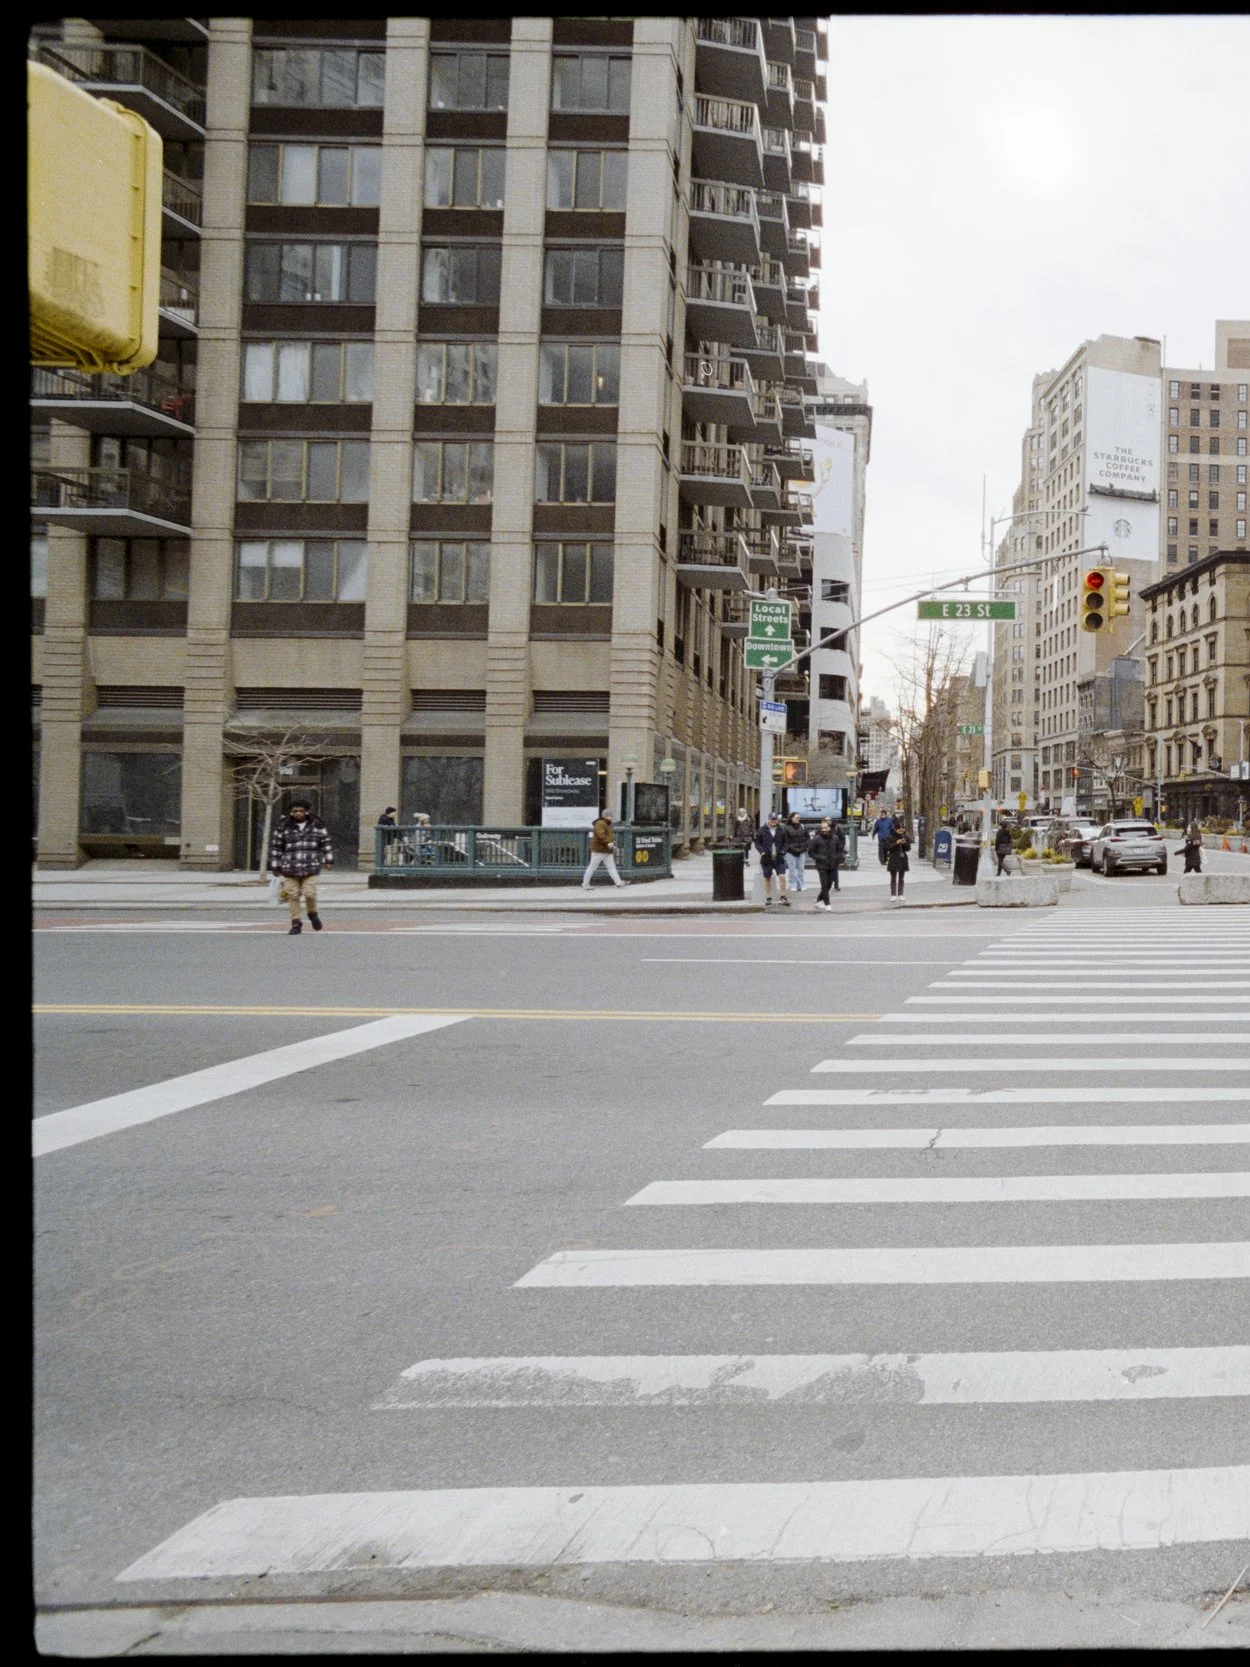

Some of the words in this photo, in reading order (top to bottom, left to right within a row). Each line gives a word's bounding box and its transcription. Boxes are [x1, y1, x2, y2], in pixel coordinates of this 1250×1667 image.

[1114, 446, 1134, 455] THE
[1093, 452, 1153, 467] STARBUCKS
[1106, 462, 1141, 473] COFFEE
[1099, 470, 1147, 483] COMPANY
[755, 604, 786, 614] Local
[942, 604, 949, 617] E
[956, 604, 971, 617] 23
[977, 604, 991, 617] St
[752, 613, 789, 624] Streets
[746, 642, 792, 652] Downtown
[545, 764, 565, 775] For
[545, 774, 592, 786] Sublease
